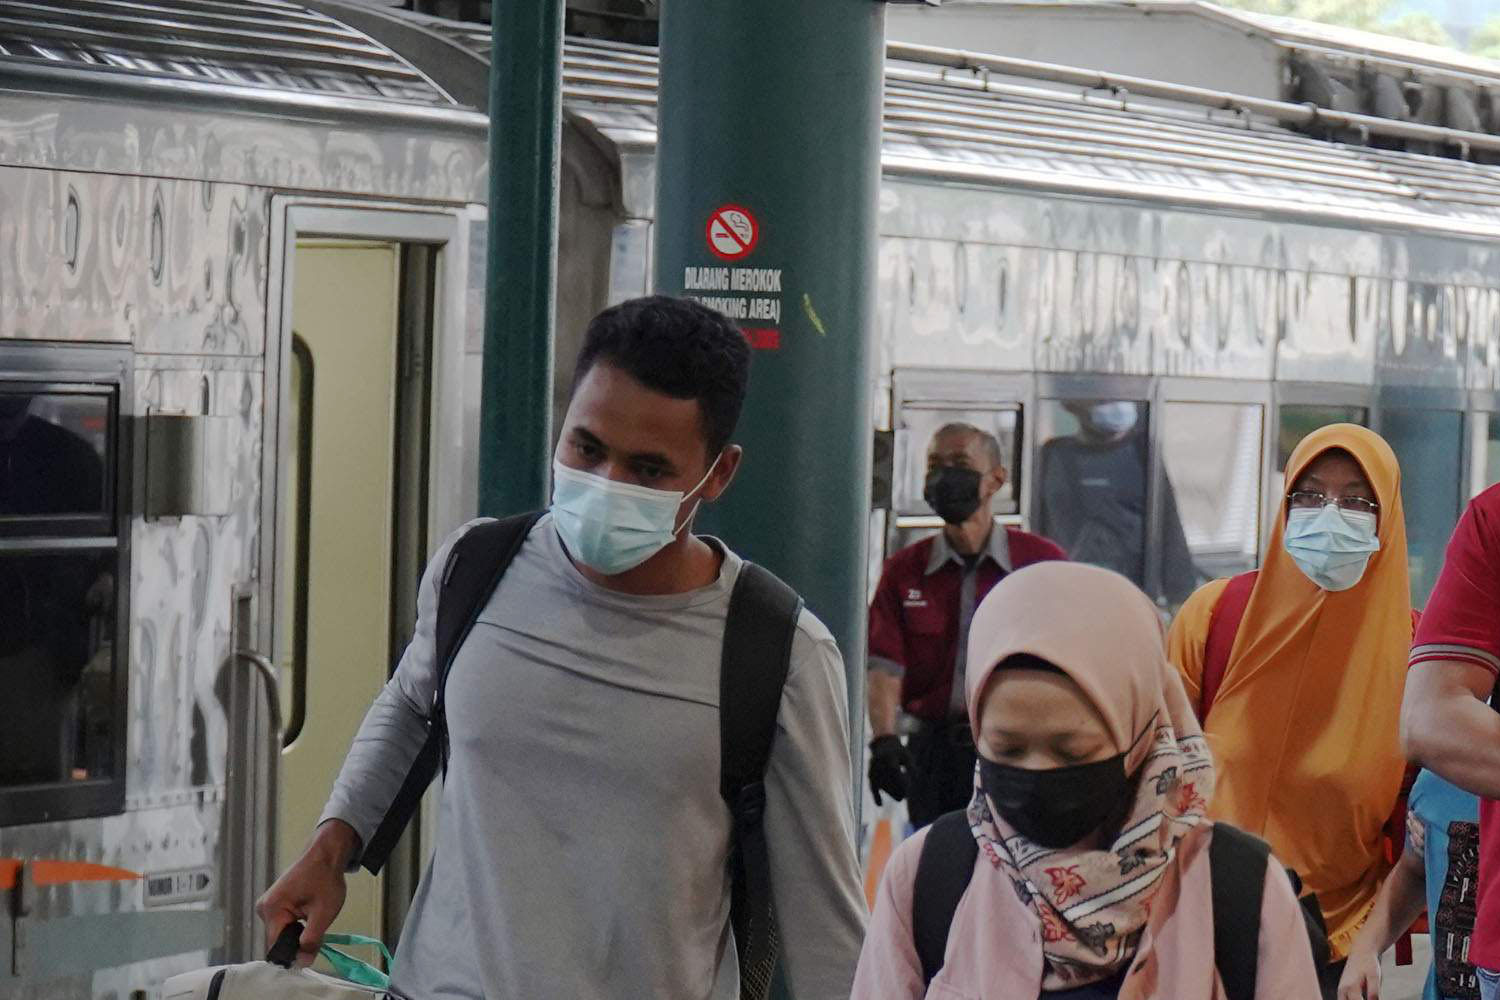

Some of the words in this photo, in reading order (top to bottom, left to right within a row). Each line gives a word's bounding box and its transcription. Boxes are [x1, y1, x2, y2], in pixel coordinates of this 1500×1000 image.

[684, 267, 729, 290] DILARANG
[731, 268, 781, 292] MEROKOK
[748, 298, 780, 324] AREA)
